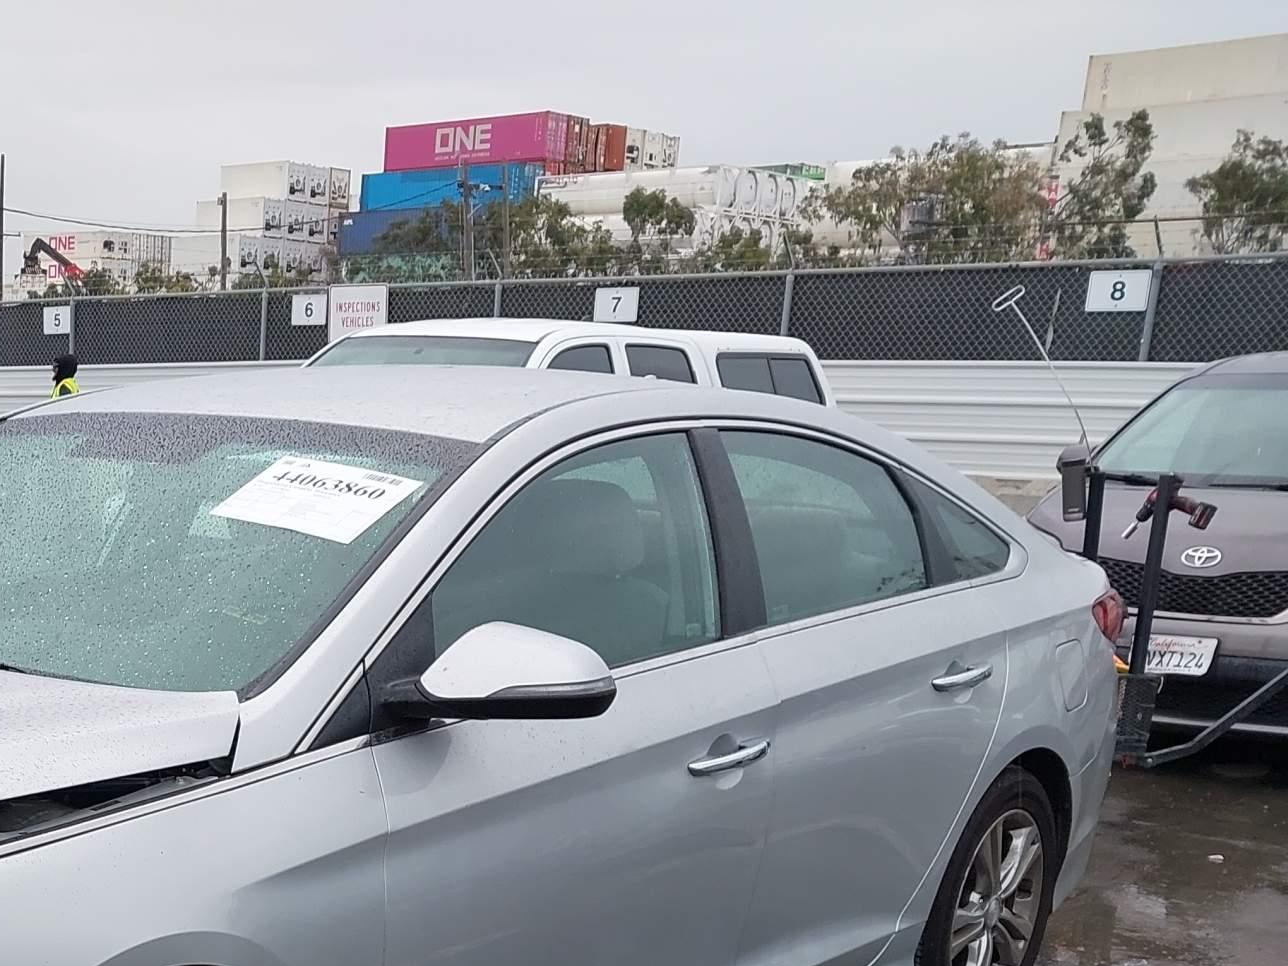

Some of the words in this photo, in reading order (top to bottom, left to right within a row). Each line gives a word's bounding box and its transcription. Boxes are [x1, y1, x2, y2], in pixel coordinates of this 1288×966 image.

[435, 123, 492, 153] ONE
[48, 236, 75, 251] ONE
[1110, 281, 1126, 301] 8
[304, 302, 314, 318] 6
[335, 301, 381, 313] INSPECTIONS
[611, 296, 622, 313] 7
[54, 313, 61, 327] 5
[341, 316, 374, 328] VEHICLES
[273, 471, 386, 500] 44063860
